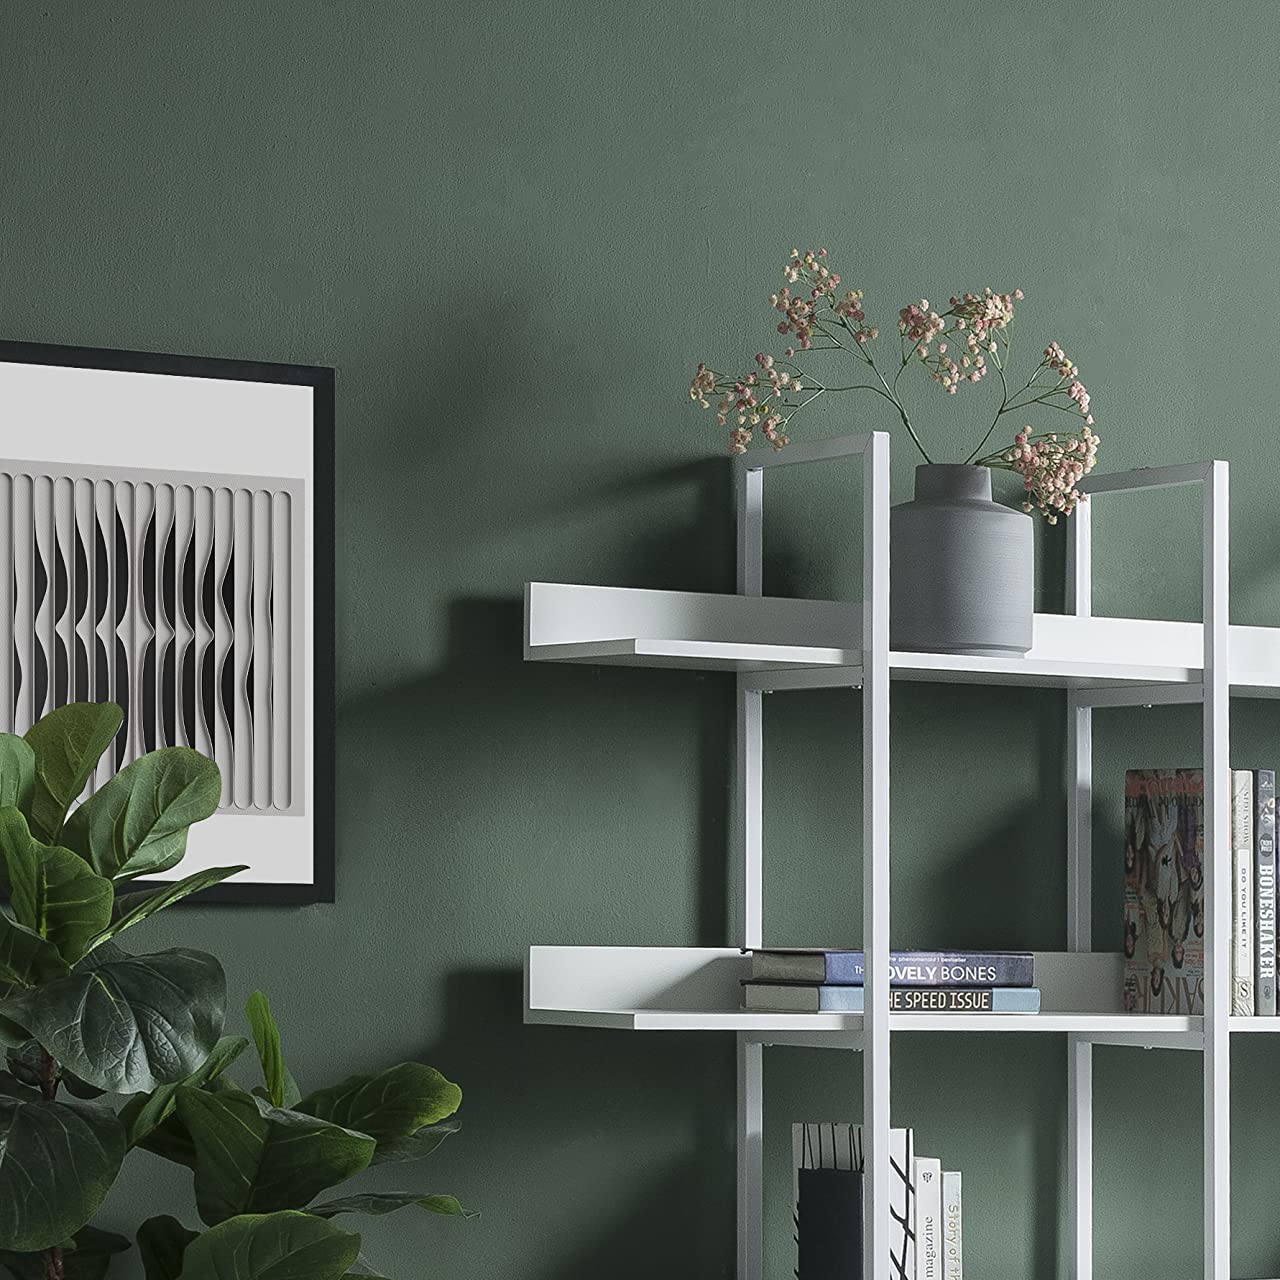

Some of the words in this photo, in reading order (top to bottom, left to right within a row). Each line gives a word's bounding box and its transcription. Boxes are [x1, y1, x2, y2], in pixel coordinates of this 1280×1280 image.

[1241, 868, 1247, 884] DO
[1259, 864, 1274, 979] BONESHAKER
[942, 966, 996, 981] BONES
[905, 992, 946, 1008] SPEED
[950, 992, 989, 1008] ISSUE
[946, 1204, 959, 1244] Story
[923, 1216, 936, 1276] magazine
[949, 1248, 960, 1264] of
